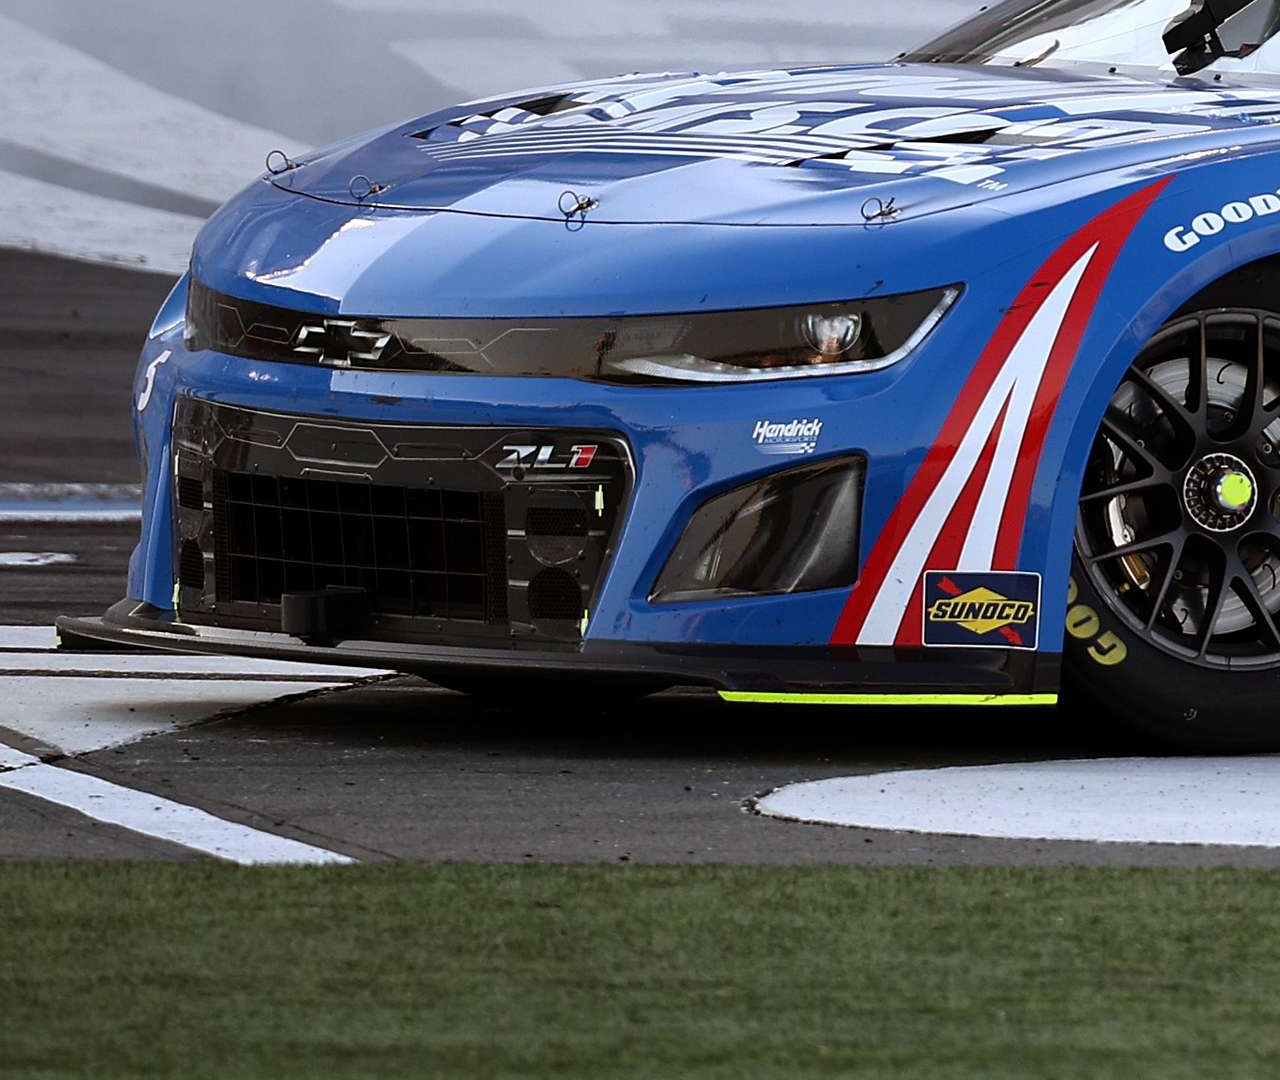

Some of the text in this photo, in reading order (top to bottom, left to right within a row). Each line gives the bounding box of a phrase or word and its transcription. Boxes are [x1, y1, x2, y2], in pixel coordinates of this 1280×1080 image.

[752, 418, 823, 444] Hendrick
[496, 445, 598, 469] ZL1
[931, 600, 1029, 623] SUNOCO
